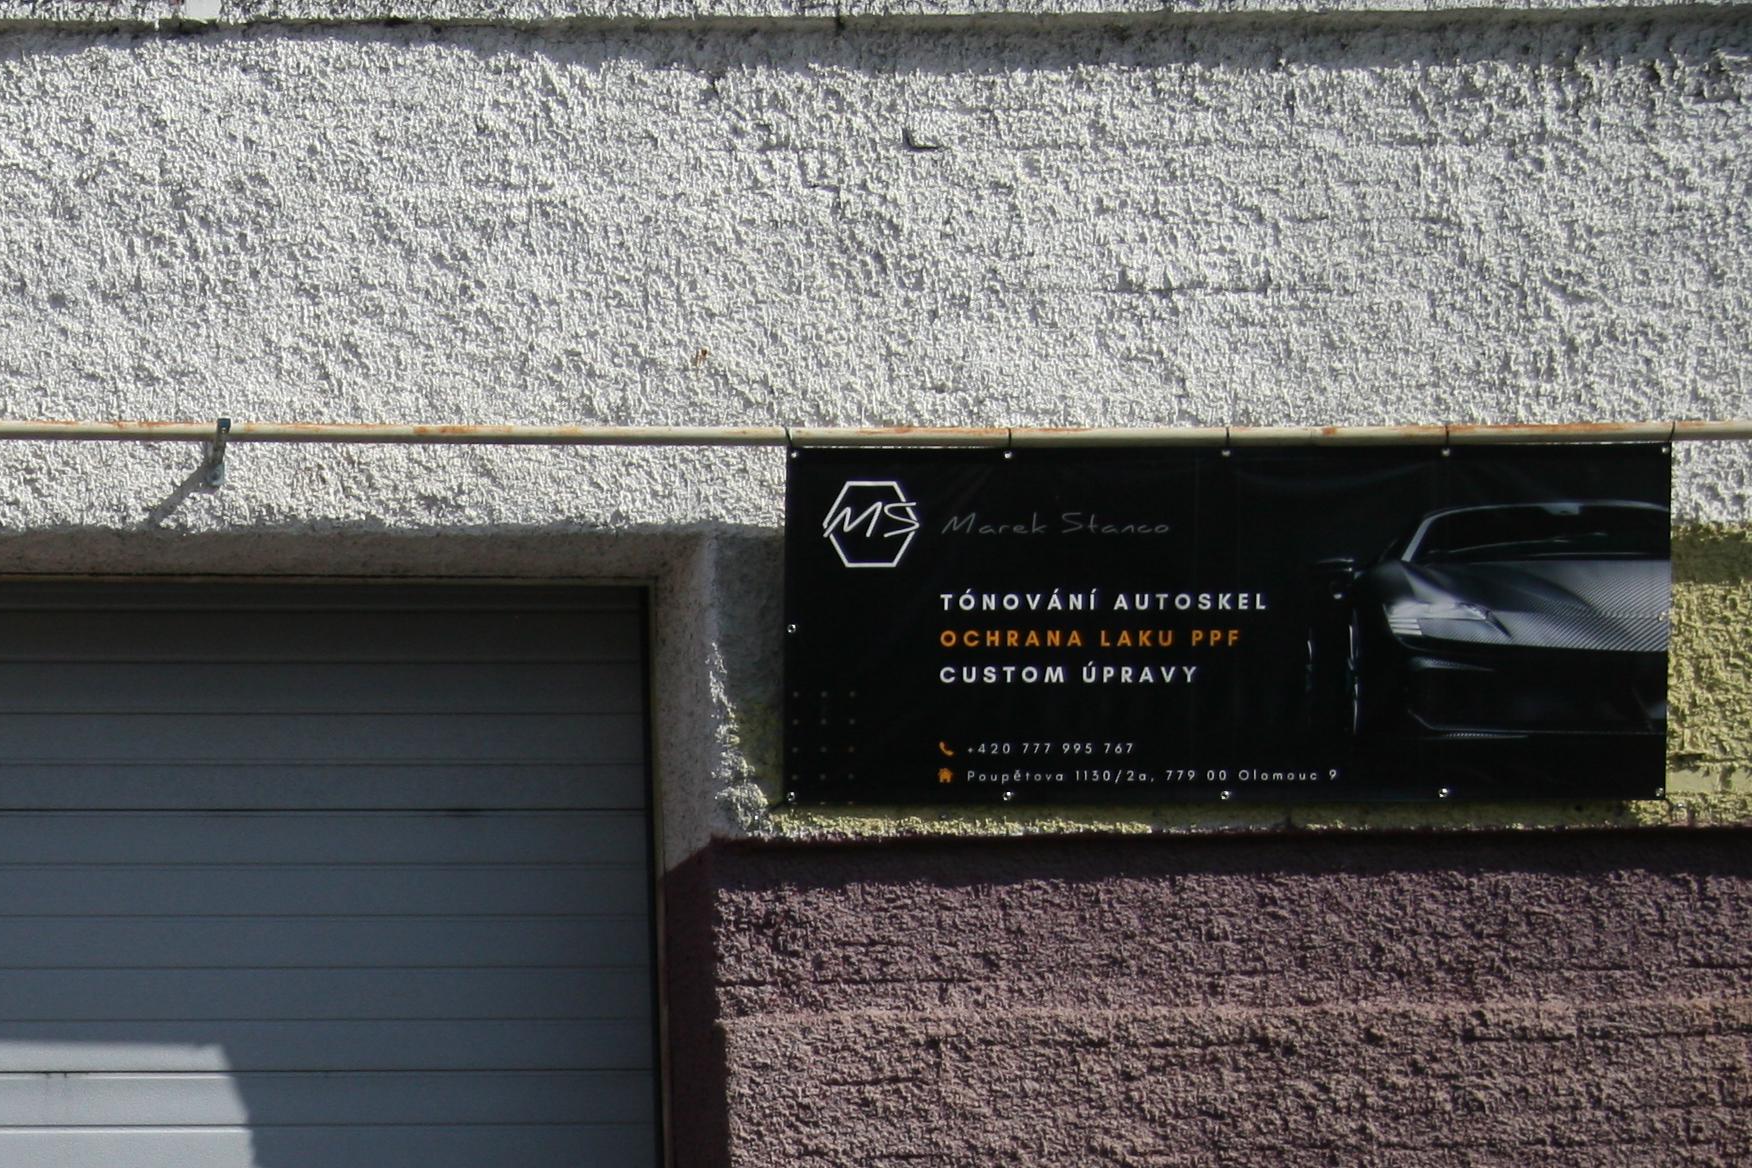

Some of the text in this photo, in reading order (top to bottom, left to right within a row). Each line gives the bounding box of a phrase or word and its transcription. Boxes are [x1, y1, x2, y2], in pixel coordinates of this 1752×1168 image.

[823, 501, 920, 538] MS
[941, 513, 1047, 535] Marek
[940, 588, 1267, 611] TÓNOVÁNÍ AUTOSKEL
[940, 629, 1241, 647] OCHRANA LAKU PPF
[939, 660, 1198, 684] CUSTOM ÚPRAVY
[967, 743, 1134, 754] +420 777 995 767
[967, 769, 1064, 784] Poupětova
[1166, 769, 1196, 781] 779
[1206, 769, 1228, 781] 00
[1238, 769, 1318, 781] Olomouc
[1328, 769, 1339, 781] 9
